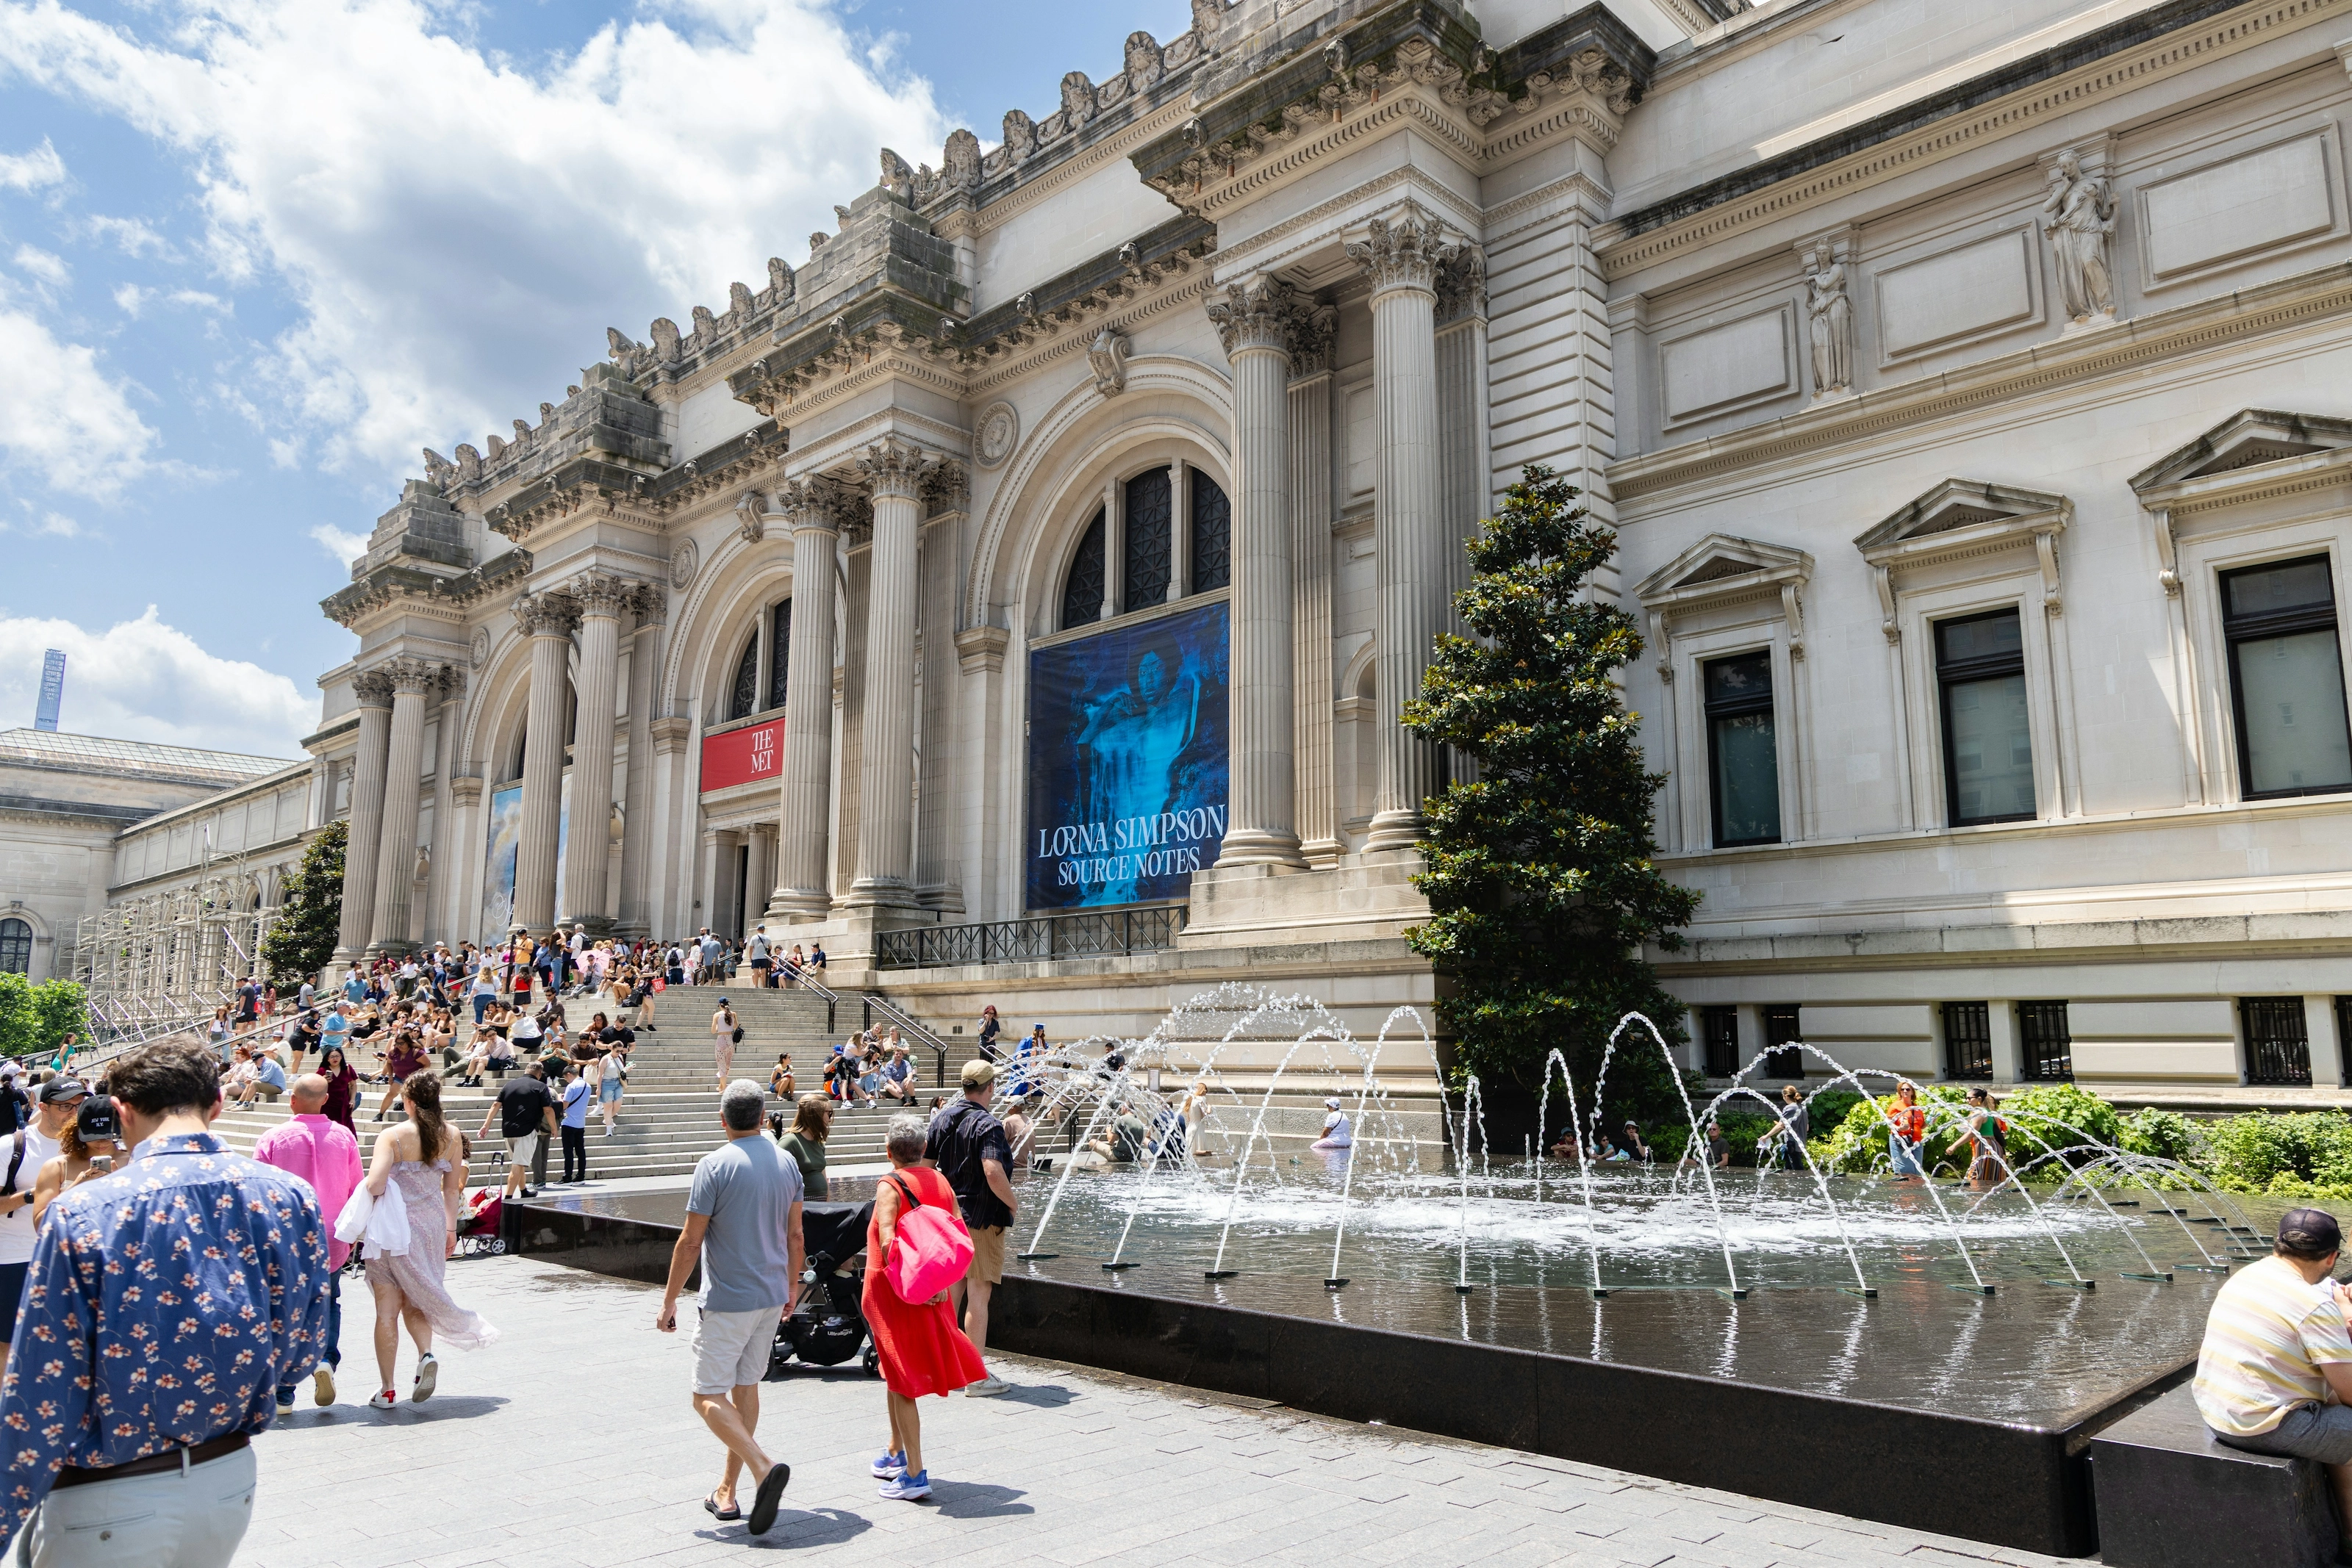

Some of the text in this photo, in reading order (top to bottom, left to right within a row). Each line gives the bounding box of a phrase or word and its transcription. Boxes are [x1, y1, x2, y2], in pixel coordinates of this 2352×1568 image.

[752, 728, 774, 752] THE
[750, 749, 774, 774] MET
[1039, 804, 1225, 858] LORNA SIMPSON
[1058, 846, 1201, 886] SOURCE NOTES
